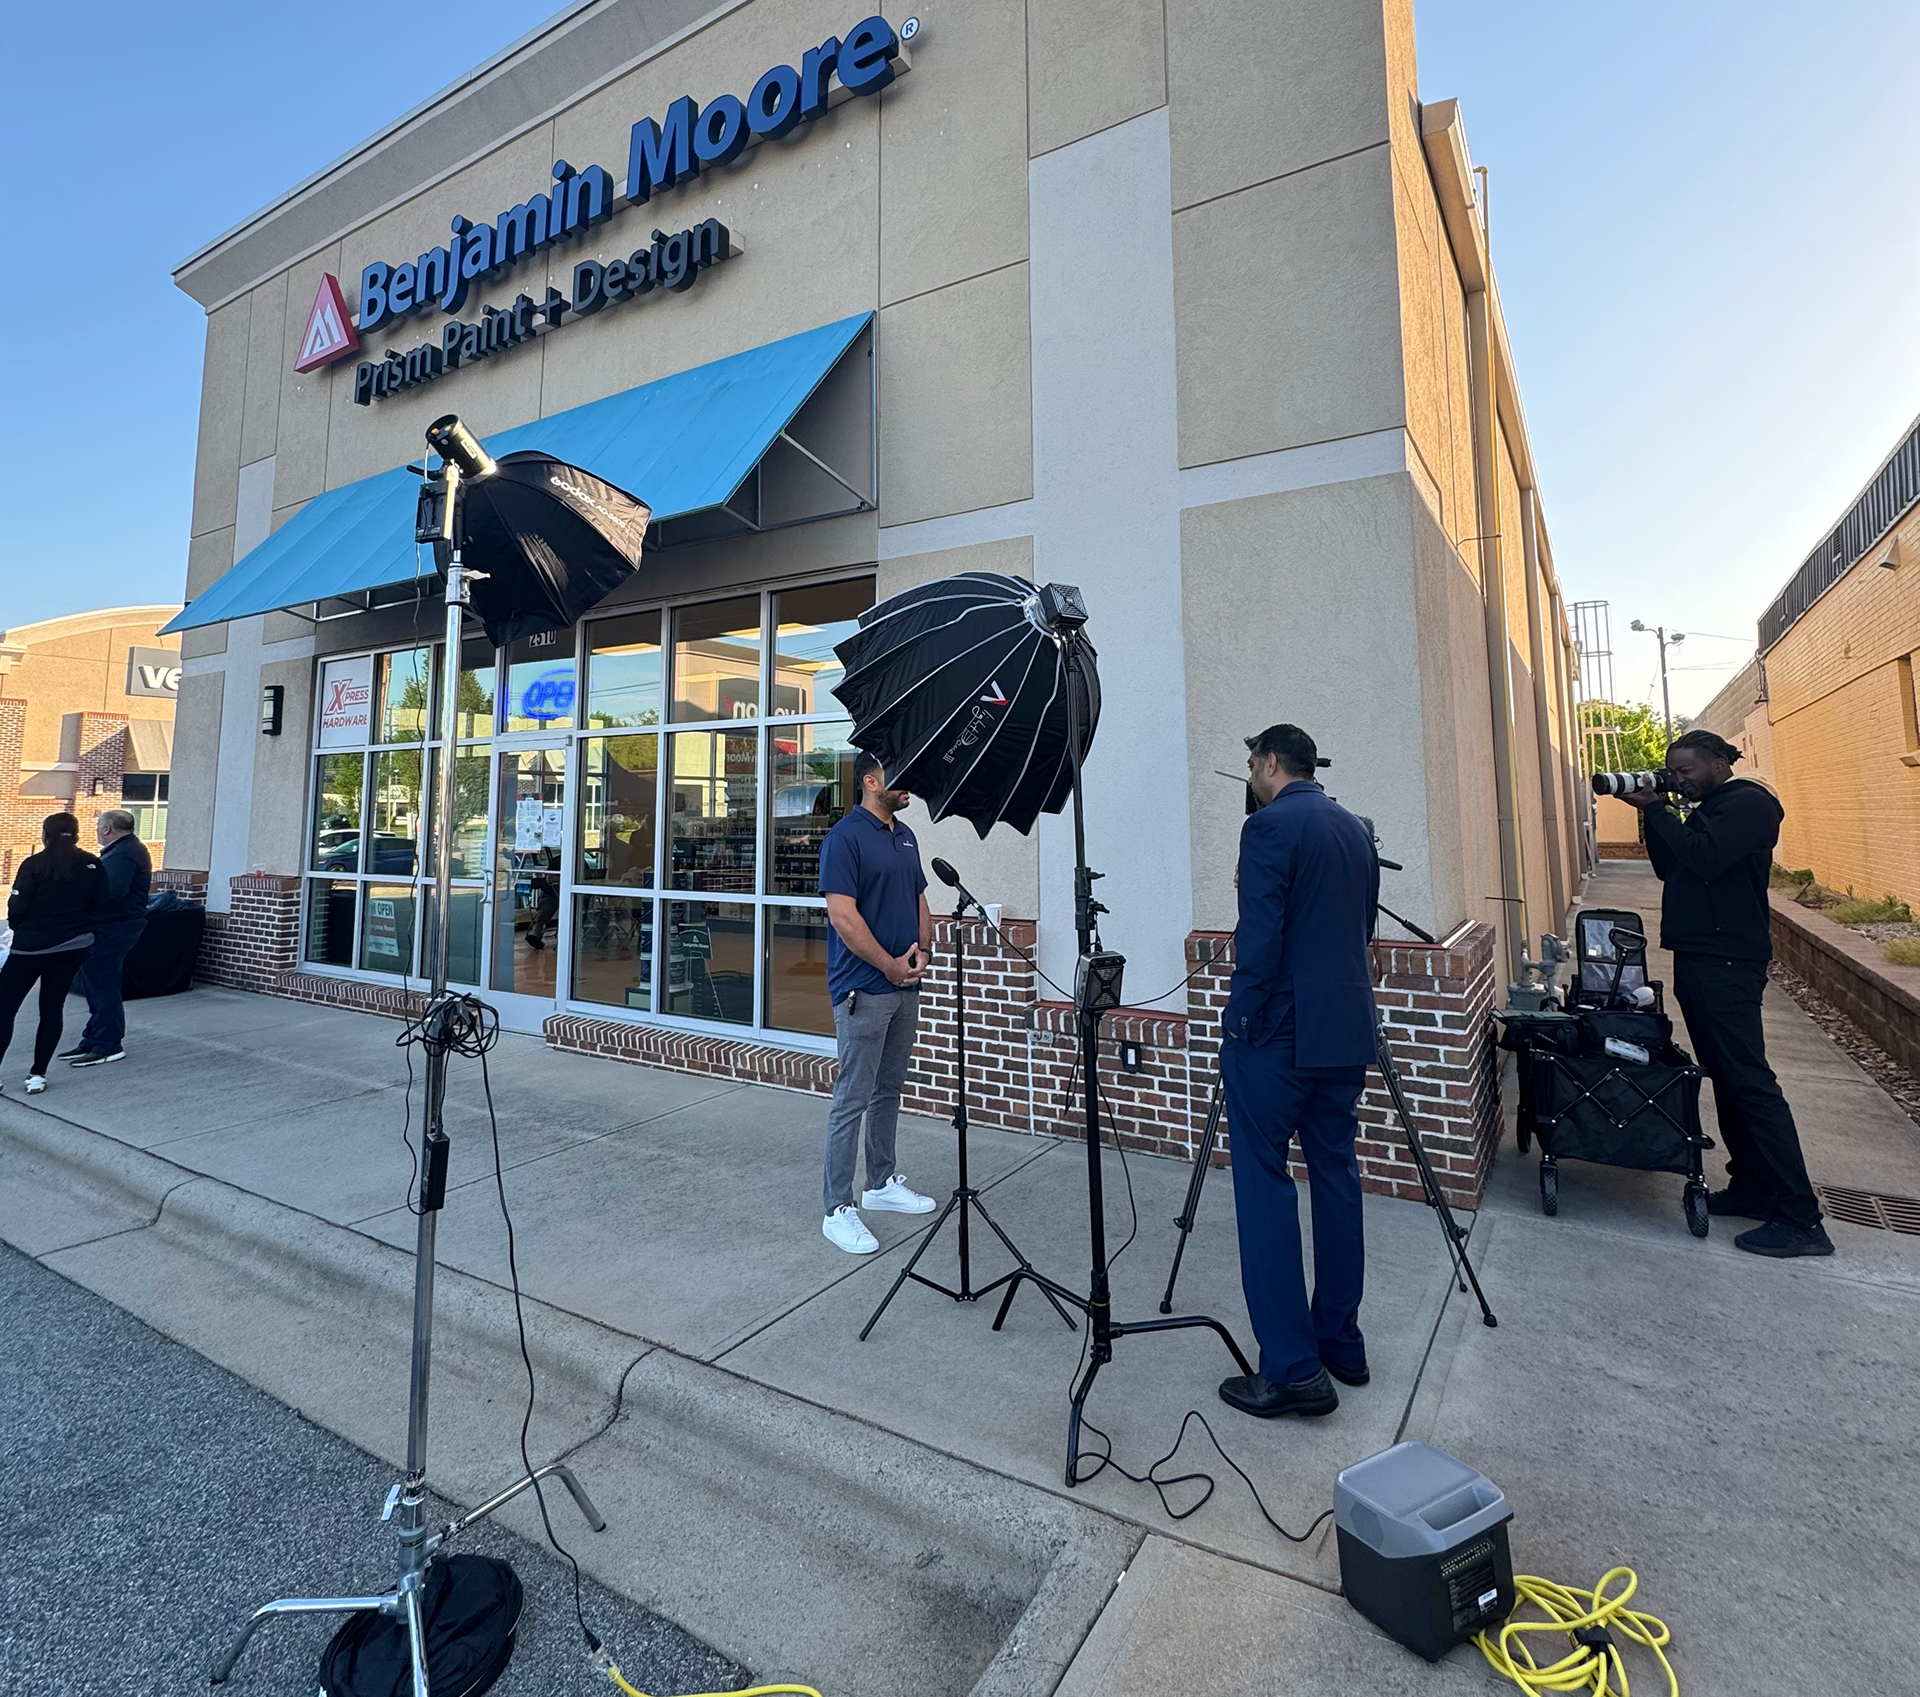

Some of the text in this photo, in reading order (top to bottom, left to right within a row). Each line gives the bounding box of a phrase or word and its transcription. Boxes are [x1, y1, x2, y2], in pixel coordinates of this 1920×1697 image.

[359, 159, 612, 332] Benjamin
[626, 15, 897, 206] Moore
[354, 343, 440, 405] Prism
[442, 293, 535, 368] Paint
[572, 218, 730, 315] Design
[530, 630, 555, 647] 2510
[324, 678, 369, 715] XPRESS
[377, 902, 393, 916] OPEN
